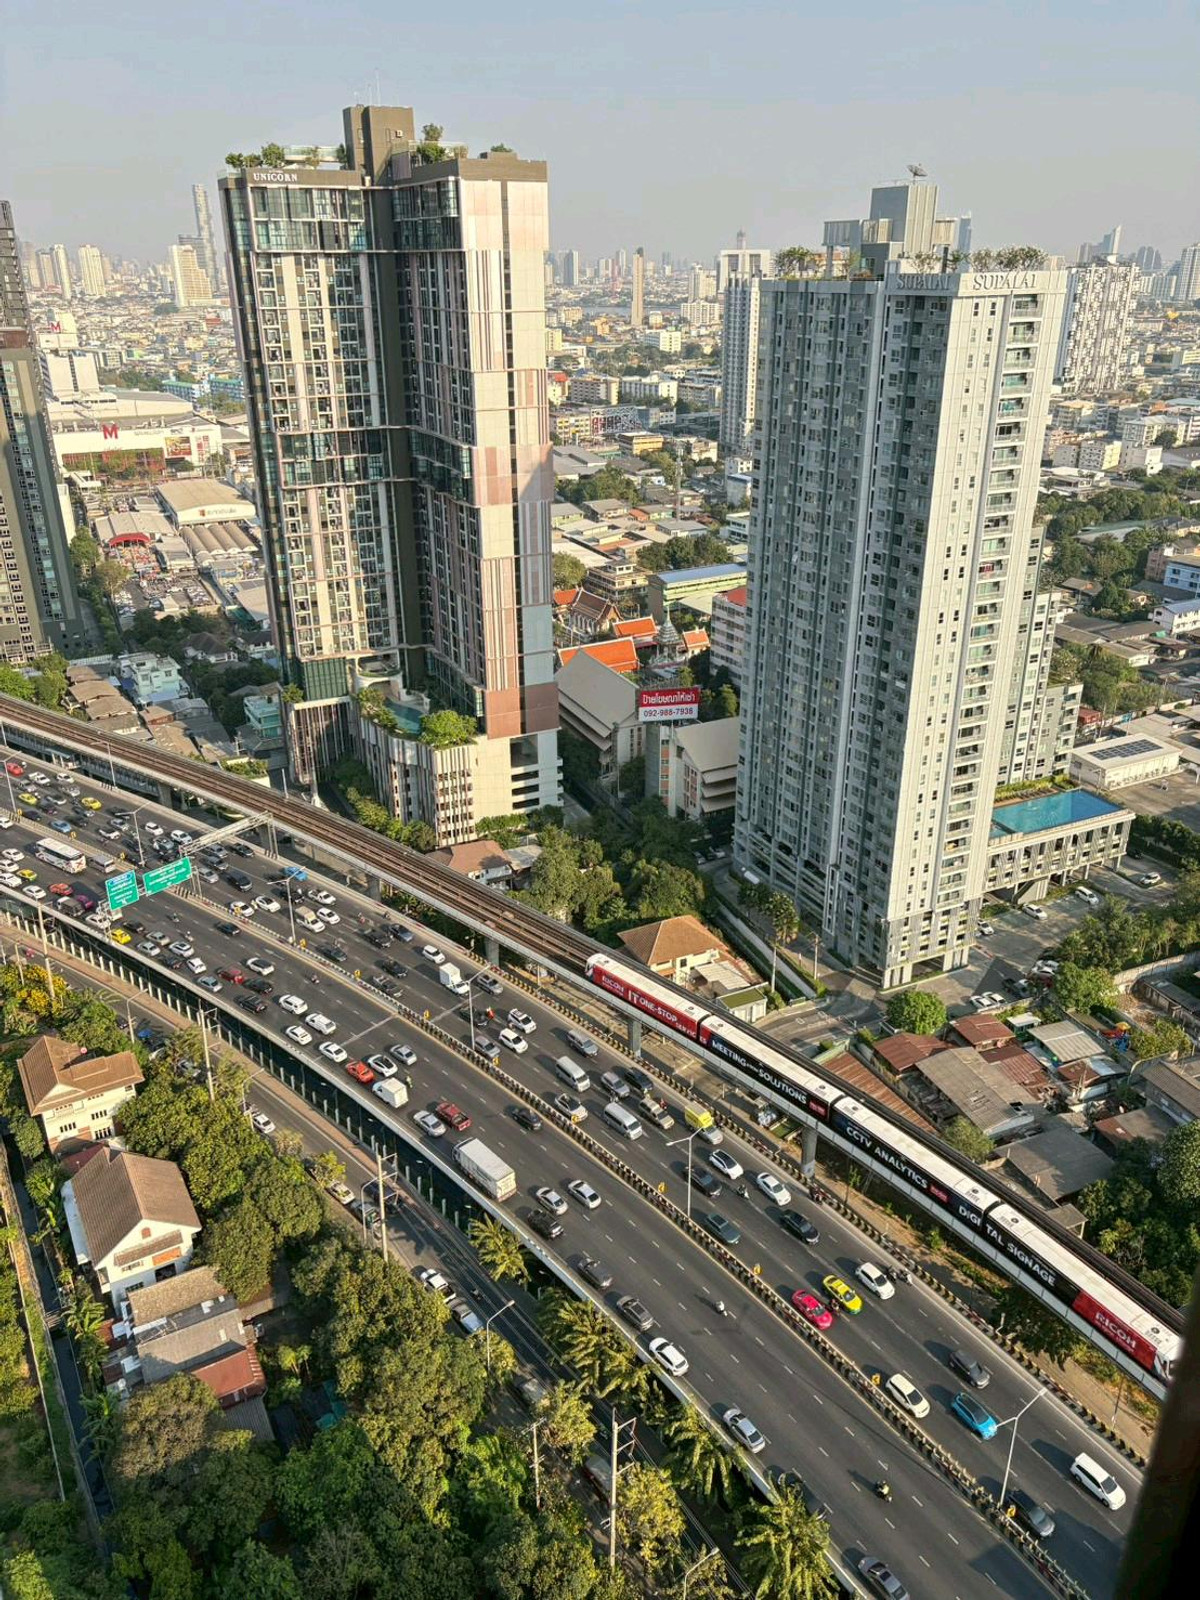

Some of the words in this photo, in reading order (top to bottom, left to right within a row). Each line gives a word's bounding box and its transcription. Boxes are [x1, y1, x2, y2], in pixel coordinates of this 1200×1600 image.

[253, 172, 298, 182] UNICORN
[973, 272, 1037, 291] SUPALAI
[102, 423, 119, 440] M
[628, 990, 640, 1004] IT
[712, 1039, 747, 1067] MEETING
[759, 1068, 807, 1105] SOLUTIONS
[846, 1126, 872, 1148] CCTV
[874, 1147, 928, 1189] ANALYTICS
[1007, 1242, 1056, 1287] SIGNAGE
[1095, 1311, 1136, 1349] RICOH
